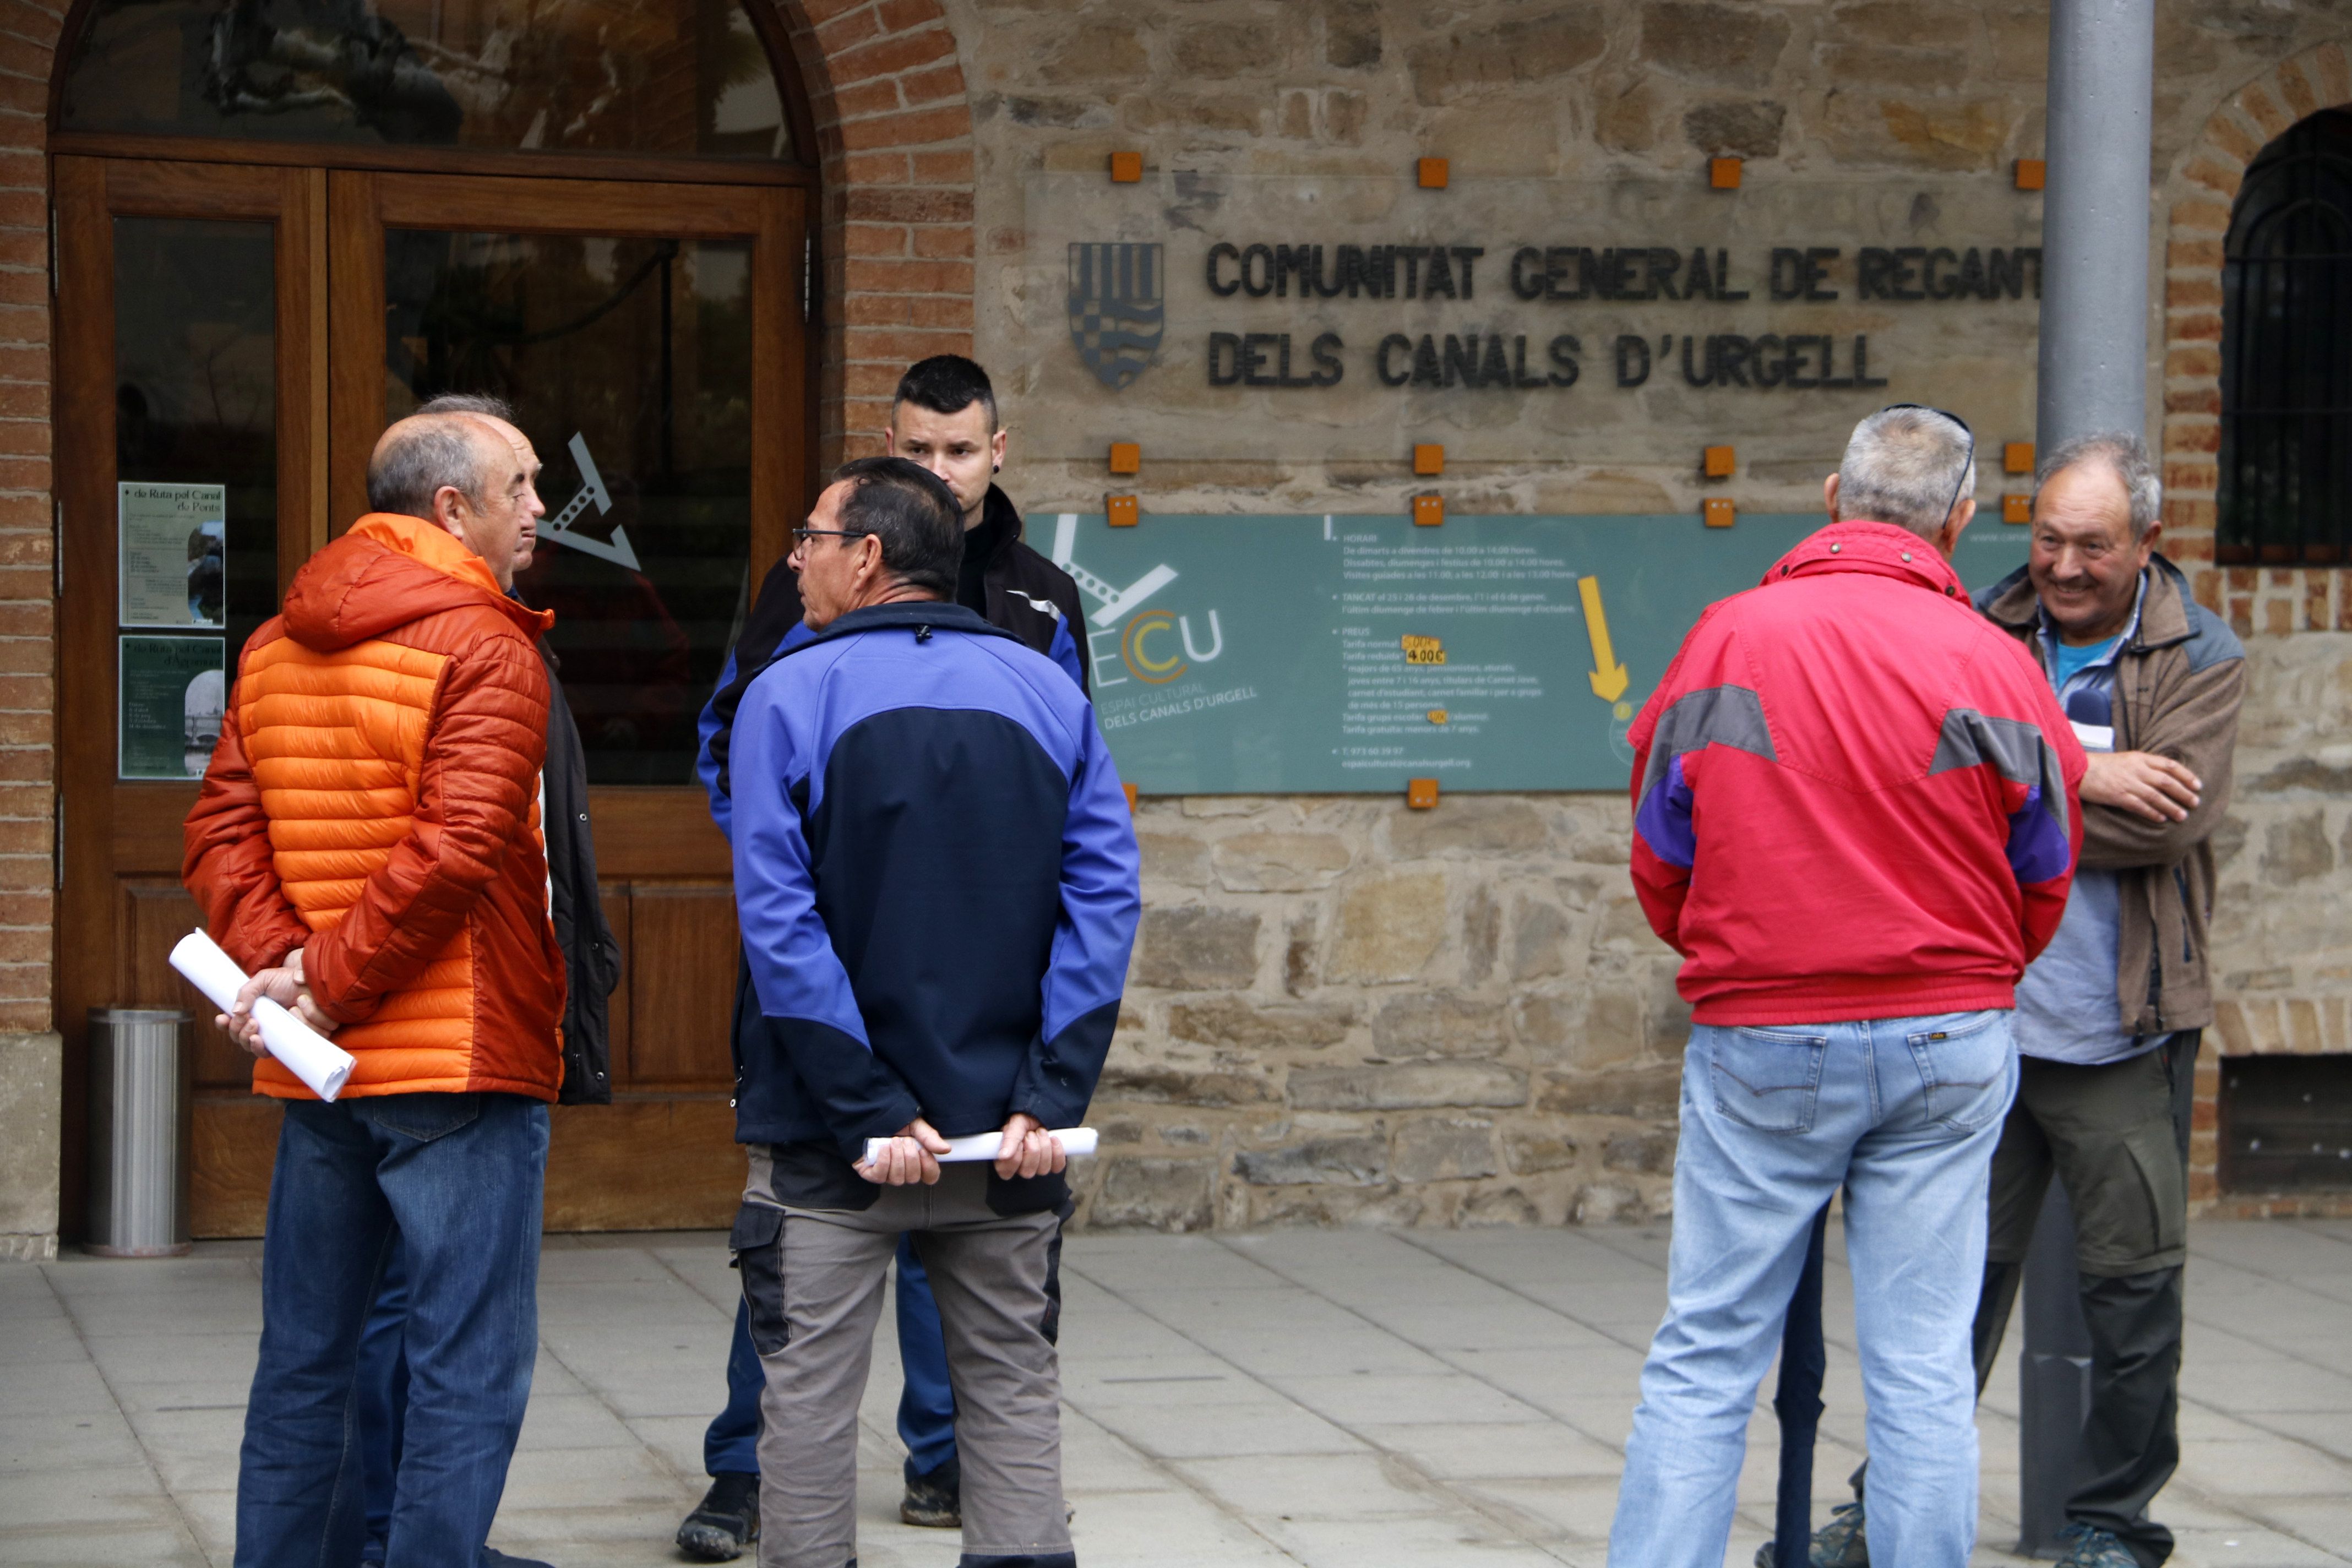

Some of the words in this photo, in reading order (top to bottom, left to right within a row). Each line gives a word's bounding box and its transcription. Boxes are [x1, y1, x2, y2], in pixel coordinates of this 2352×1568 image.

[1206, 243, 1484, 300] COMUNITAT
[1511, 246, 1749, 301] GENERAL
[1770, 247, 1840, 300] DE
[1858, 247, 2041, 300] REGANT
[1209, 332, 1344, 387] DELS
[1376, 333, 1581, 388] CANALS
[1616, 334, 1887, 388] D'URGELL
[149, 488, 172, 499] Ruta
[192, 489, 221, 500] Canal
[192, 502, 221, 512] Ponts
[1343, 534, 1378, 543] HORARI
[1969, 532, 2033, 542] www.canal
[1343, 546, 1355, 554] De
[1357, 546, 1390, 554] dimarts
[1398, 546, 1440, 554] divendres
[1441, 546, 1453, 554] de
[1455, 546, 1477, 554] 10.00
[1343, 558, 1385, 568] Dissabtes,
[1387, 558, 1435, 568] diumenges
[1440, 558, 1468, 567] festius
[1469, 558, 1481, 567] de
[1343, 570, 1371, 579] Visites
[1371, 570, 1406, 581] guiades
[1414, 570, 1427, 579] les
[1461, 570, 1474, 579] les
[1513, 570, 1526, 579] les
[1342, 593, 1376, 601] TANCAT
[1377, 592, 1385, 601] el
[1387, 593, 1398, 601] 25
[1404, 593, 1415, 601] 26
[1415, 592, 1428, 601] de
[1428, 592, 1473, 602] desembre,
[1490, 592, 1499, 601] el
[1499, 593, 1506, 601] 6
[1507, 592, 1519, 601] de
[1370, 605, 1415, 616] diumenge
[1415, 605, 1428, 614] de
[1428, 605, 1454, 614] febrer
[1488, 605, 1532, 616] diumenge
[1342, 627, 1370, 636] PREUS
[1342, 640, 1366, 649] Tarifa
[1342, 652, 1366, 661] Tarifa
[1348, 665, 1377, 674] majors
[1378, 664, 1390, 673] de
[1391, 664, 1402, 673] 65
[1347, 677, 1370, 687] joves
[1442, 676, 1473, 684] titulars
[1474, 676, 1486, 684] de
[1487, 676, 1516, 684] Carnet
[1347, 689, 1375, 698] carnet
[1427, 689, 1455, 698] carnet
[1455, 688, 1488, 697] familiar
[1494, 689, 1509, 698] per
[1516, 690, 1542, 699] grups
[1101, 697, 1136, 715] ESPAI
[1138, 683, 1206, 706] CULTURAL
[1104, 712, 1137, 729] DELS
[1140, 700, 1191, 722] CANALS
[1194, 686, 1257, 710] D'URGELL
[1347, 701, 1359, 709] de
[1360, 701, 1378, 709] més
[1379, 701, 1391, 709] de
[1393, 701, 1403, 709] 15
[1342, 712, 1366, 721] Tarifa
[1366, 714, 1392, 723] grups
[1342, 725, 1366, 734] Tarifa
[1438, 725, 1450, 734] de
[1451, 726, 1456, 734] 7
[1350, 747, 1366, 755] 973
[1368, 747, 1380, 755] 60
[1392, 747, 1404, 755] 97
